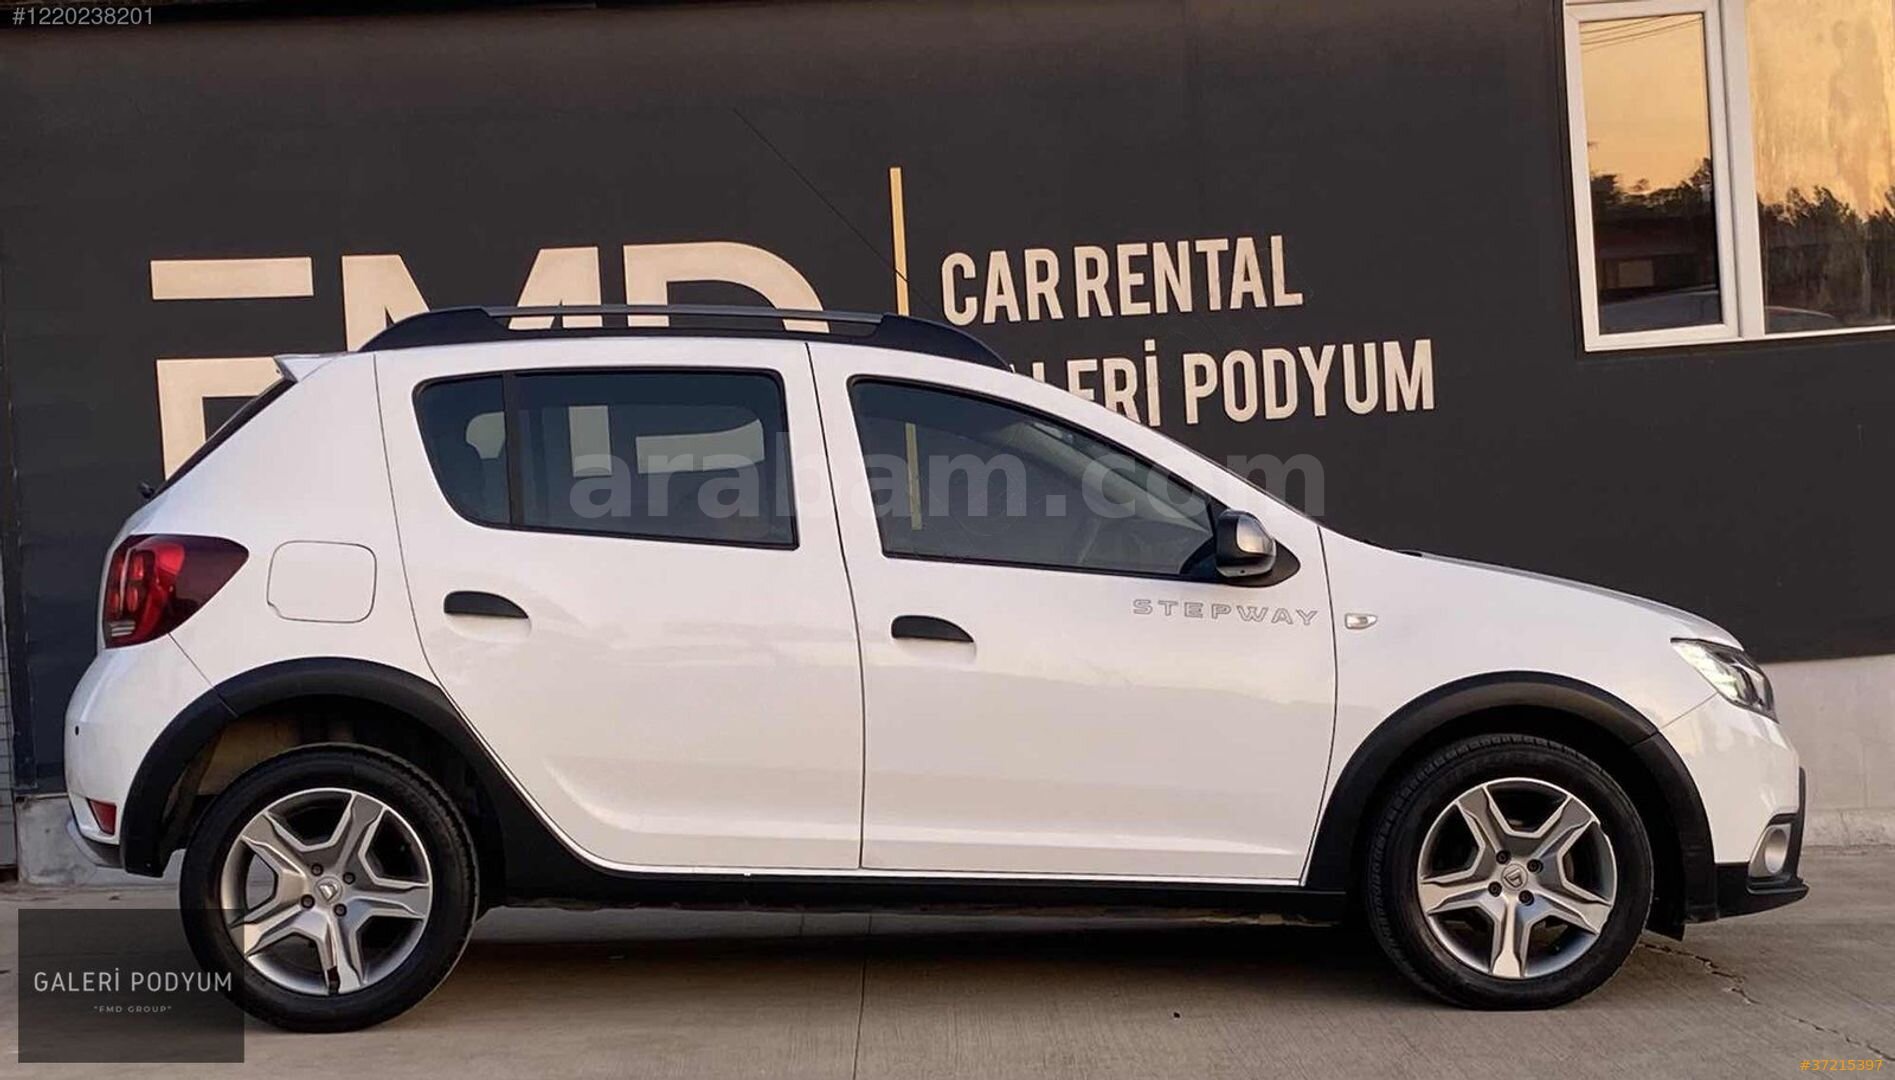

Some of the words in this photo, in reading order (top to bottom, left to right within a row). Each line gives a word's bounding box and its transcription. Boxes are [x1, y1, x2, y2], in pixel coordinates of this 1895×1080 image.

[941, 247, 1063, 326] CAR
[1074, 234, 1303, 319] RENTAL
[1009, 339, 1161, 427] ERİ
[1182, 339, 1435, 425] PODYUM
[1133, 599, 1318, 625] STEPWAY
